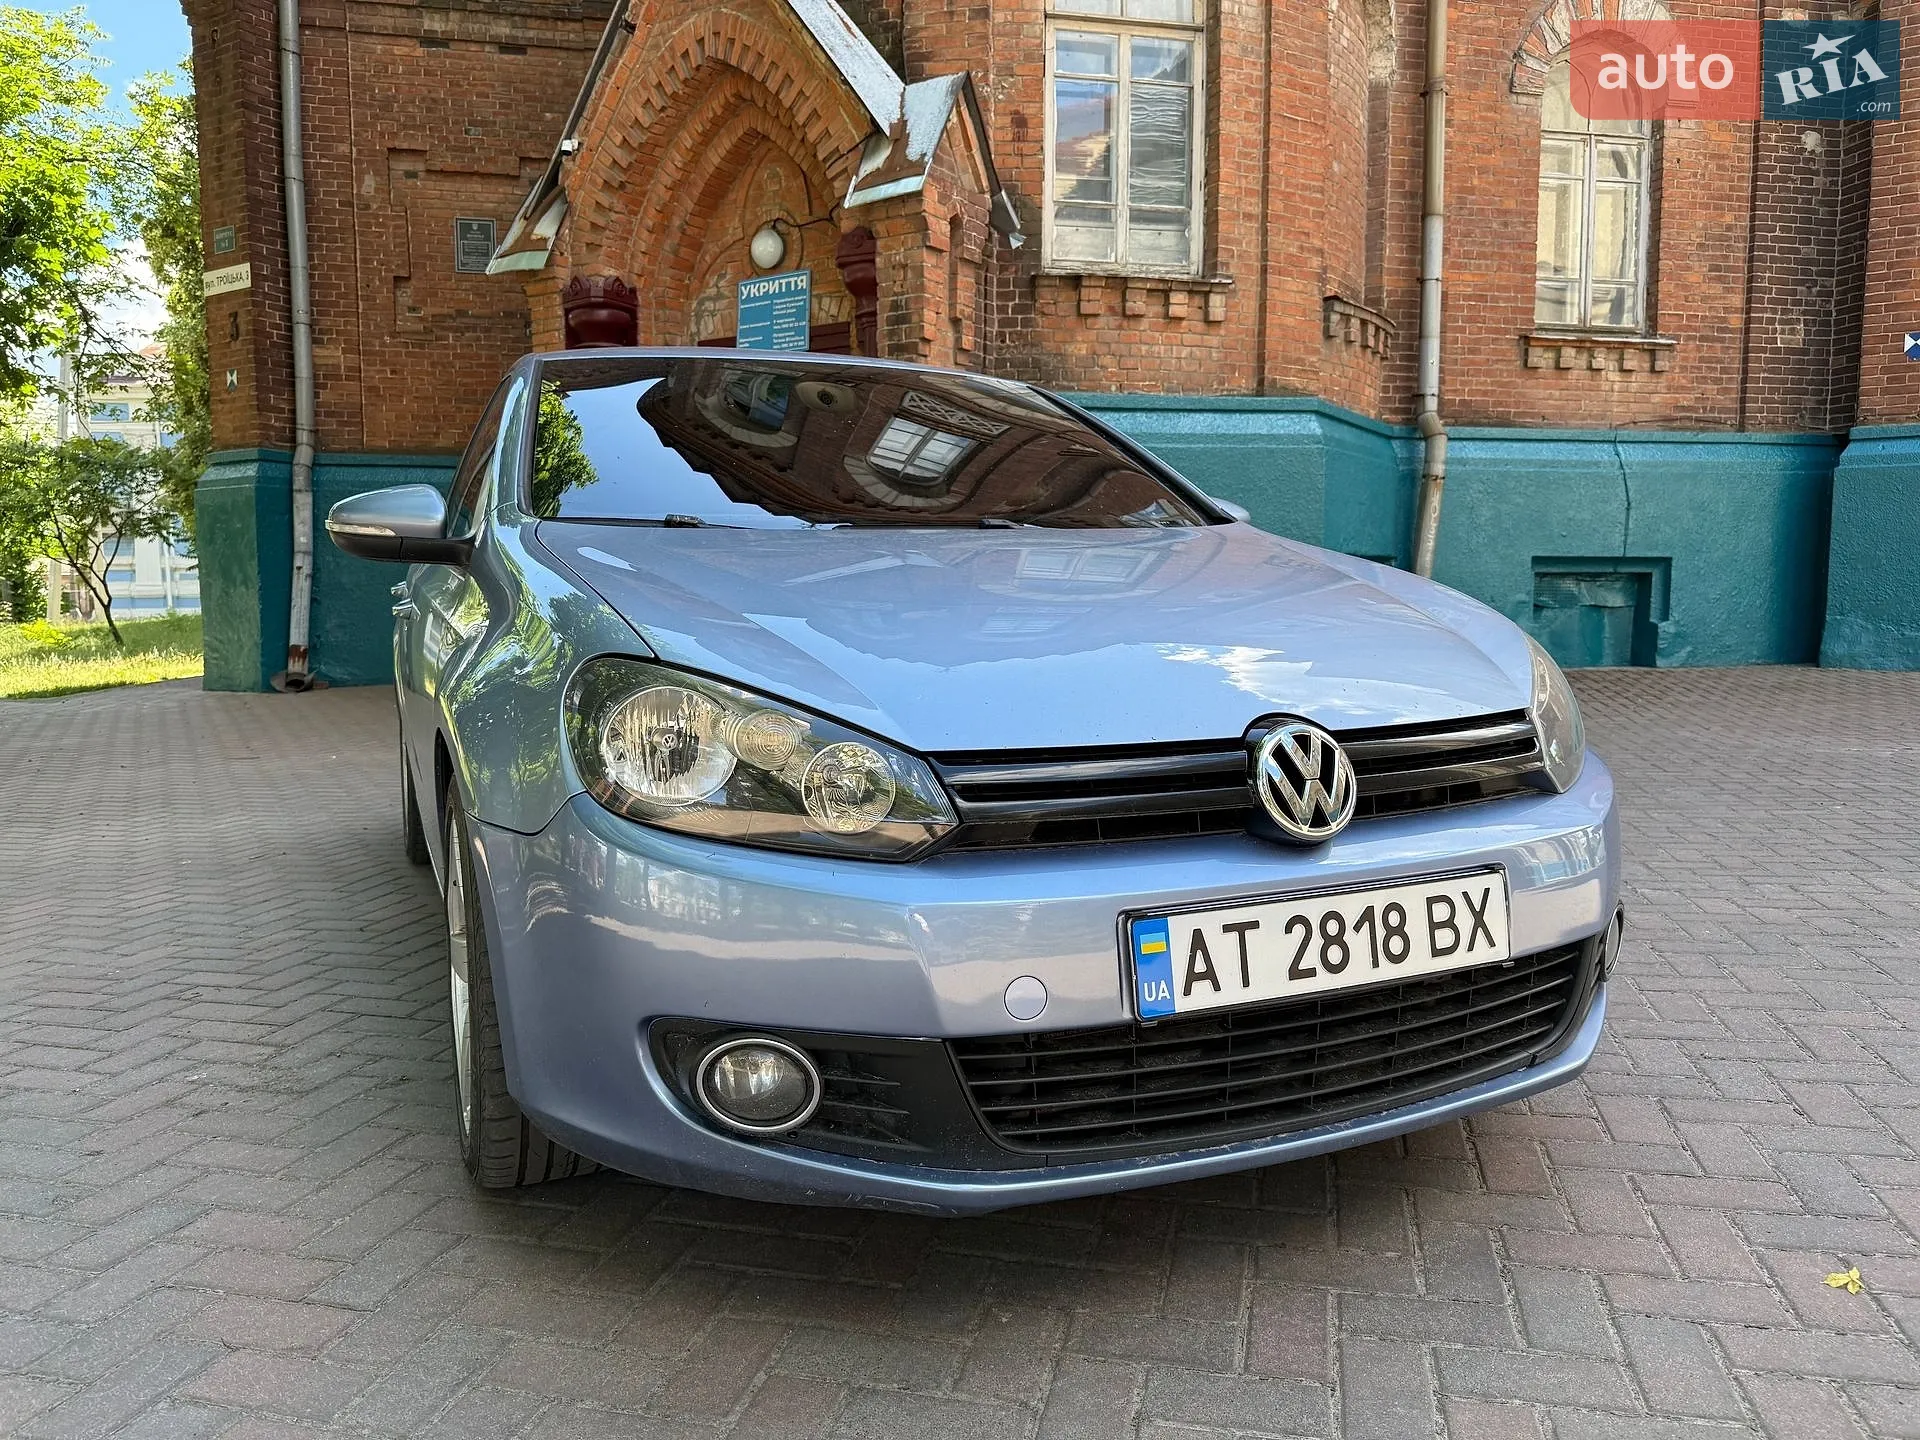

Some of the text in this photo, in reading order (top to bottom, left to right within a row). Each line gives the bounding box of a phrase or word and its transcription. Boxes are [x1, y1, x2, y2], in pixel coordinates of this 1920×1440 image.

[741, 275, 807, 299] УКРИТТЯ
[1261, 727, 1352, 832] VW
[1183, 887, 1497, 997] AT 2818 BX
[1144, 980, 1171, 1002] UA
